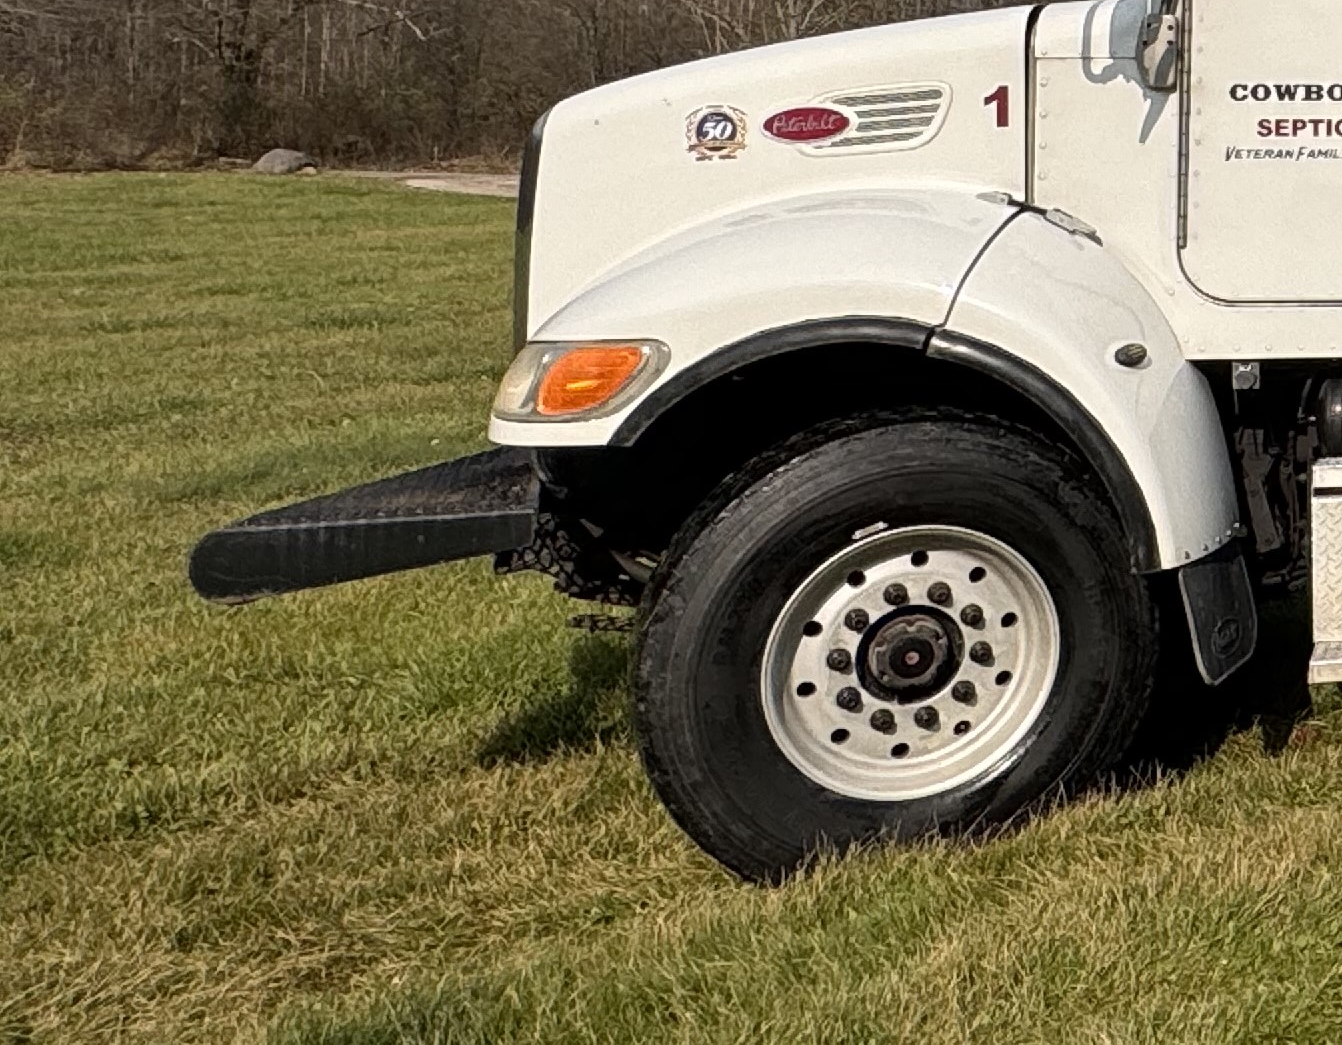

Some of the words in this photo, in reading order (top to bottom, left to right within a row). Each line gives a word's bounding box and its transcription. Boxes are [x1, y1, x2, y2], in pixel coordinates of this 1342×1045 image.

[983, 85, 1010, 128] 1
[702, 121, 733, 140] 50
[772, 113, 842, 135] Peterbilt
